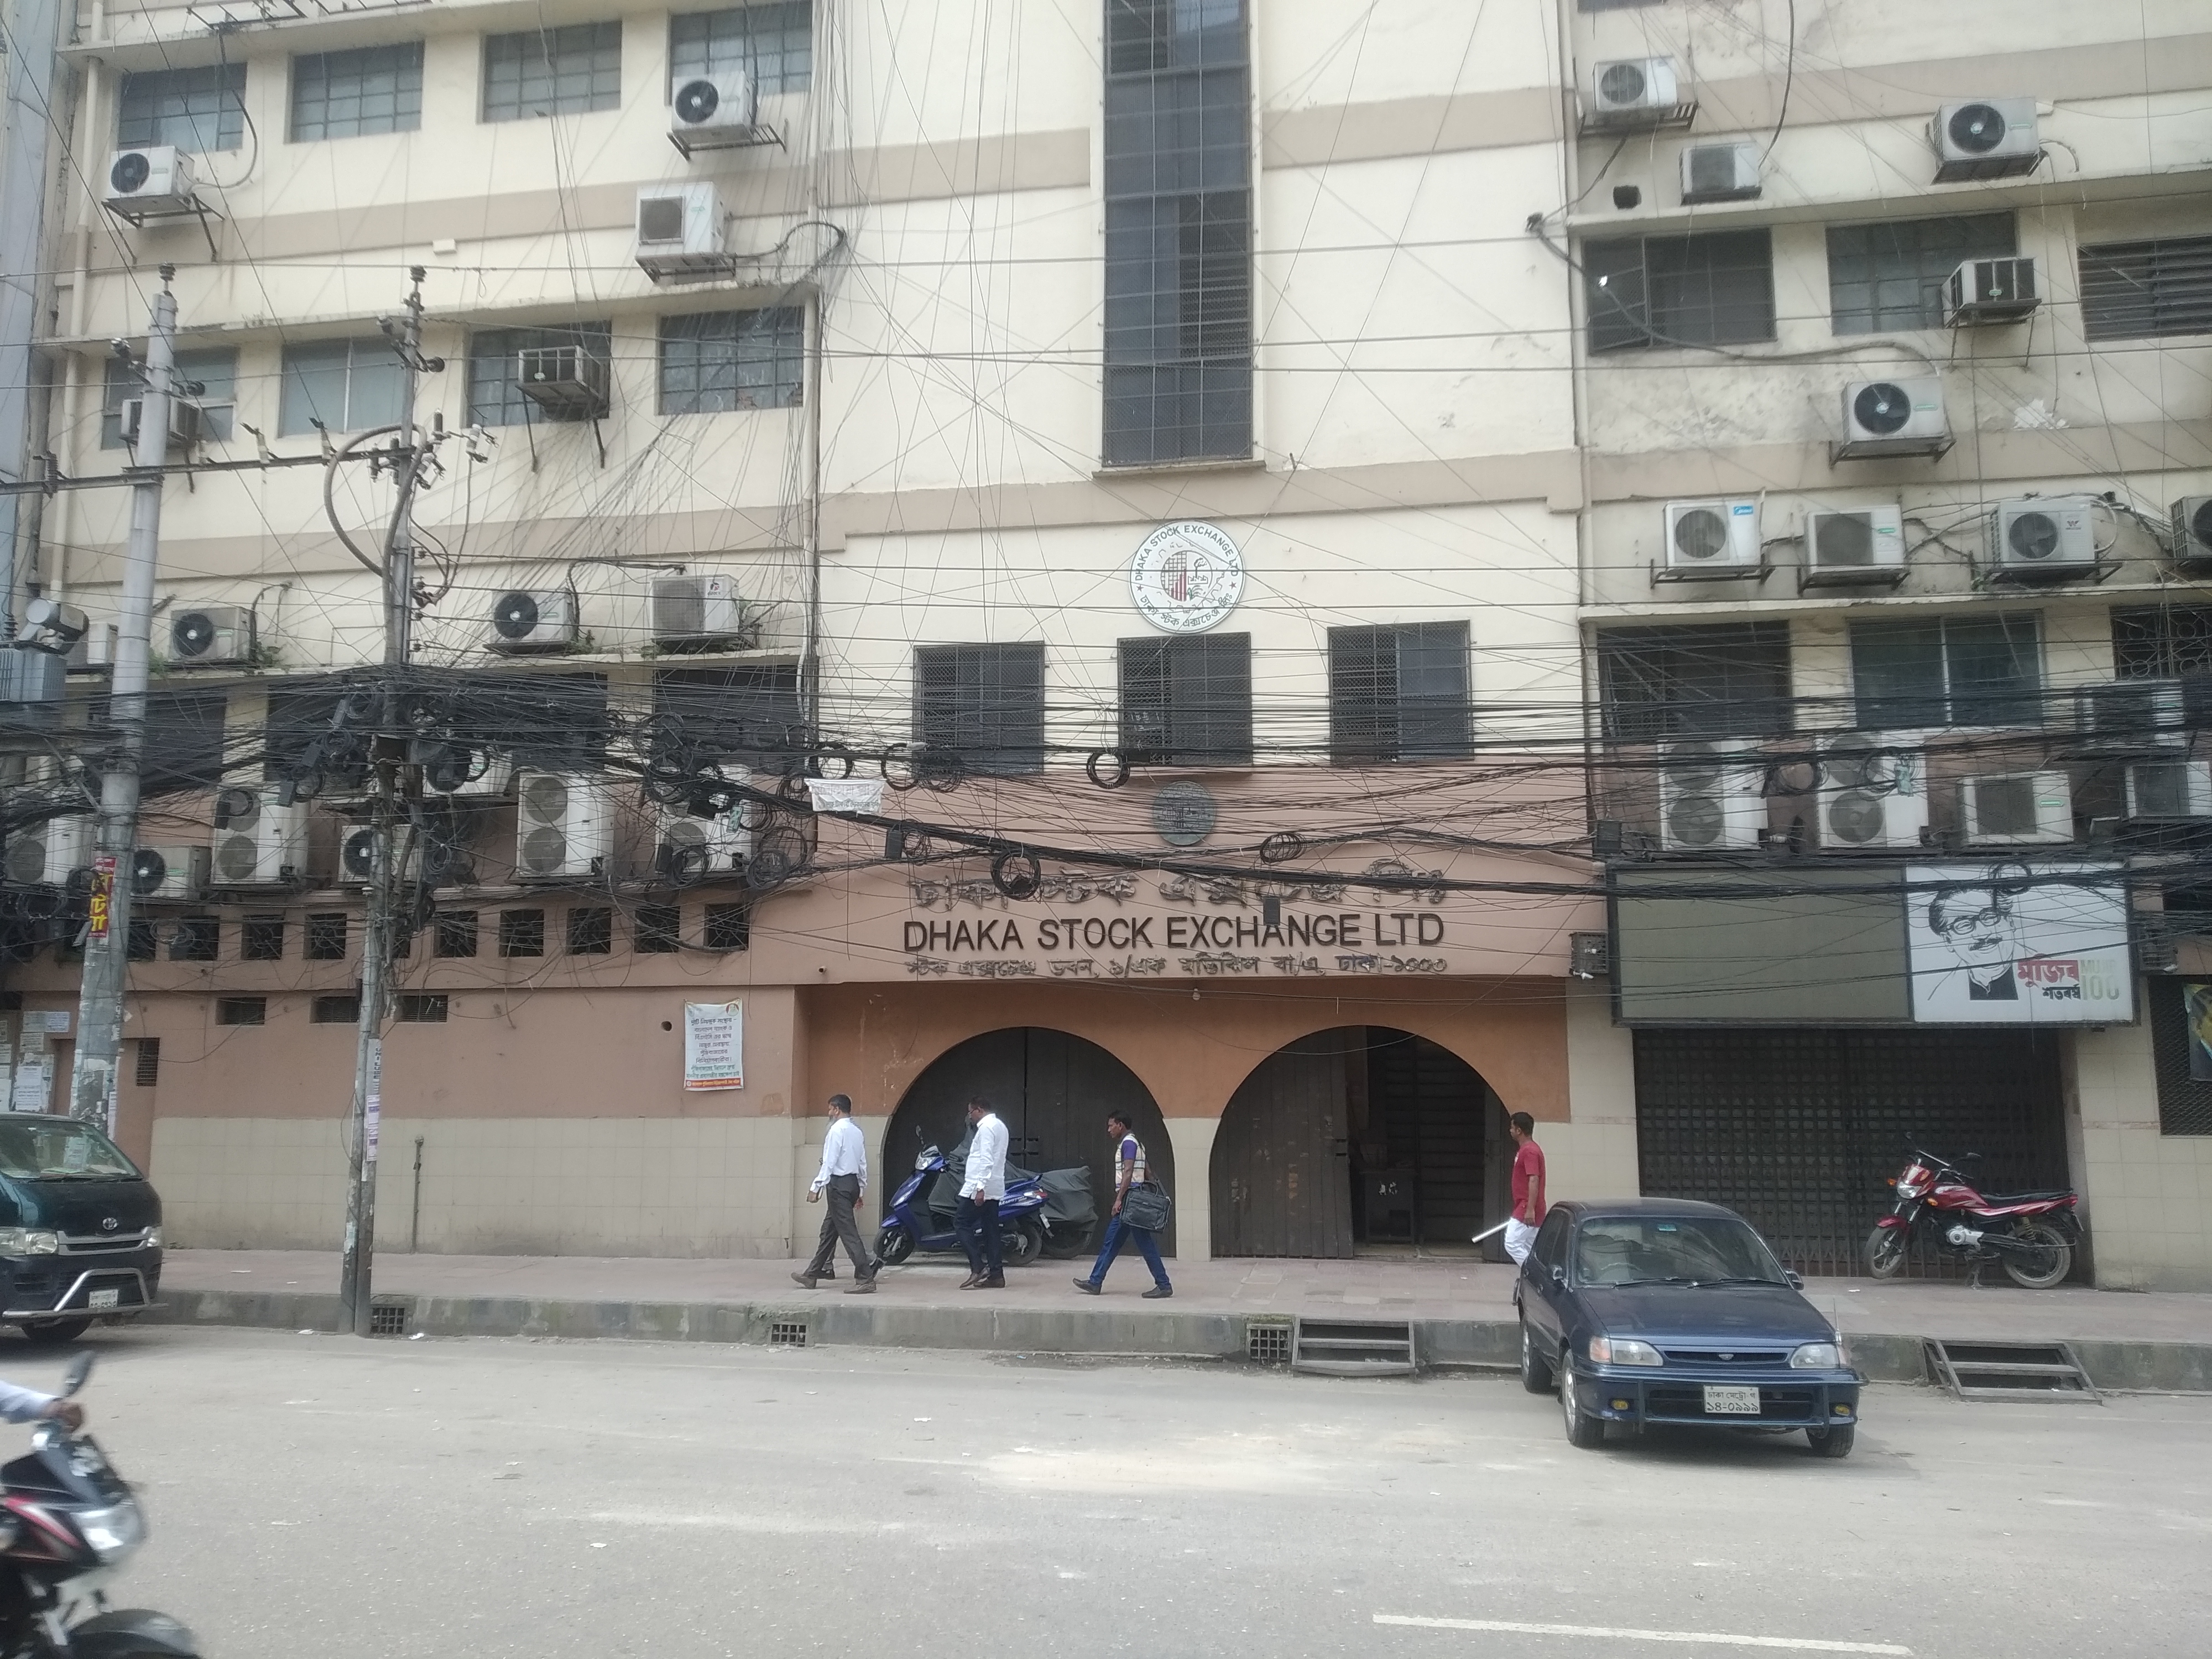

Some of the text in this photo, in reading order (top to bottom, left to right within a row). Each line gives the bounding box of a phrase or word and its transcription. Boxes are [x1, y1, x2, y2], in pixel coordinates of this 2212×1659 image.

[1135, 548, 1152, 581] DHAKA
[1150, 525, 1181, 547] STOCK
[1184, 525, 1234, 557] EXCHANGE
[1140, 594, 1159, 616] ঢাকা
[1161, 613, 1180, 627] স্টক
[904, 913, 1444, 952] DHAKA STOCK EXCHANGE LTD
[2018, 953, 2080, 988] মুজিব
[2042, 983, 2081, 1000] শতবর্ষ
[1707, 1402, 1759, 1412] ১৪-০৯৯৯
